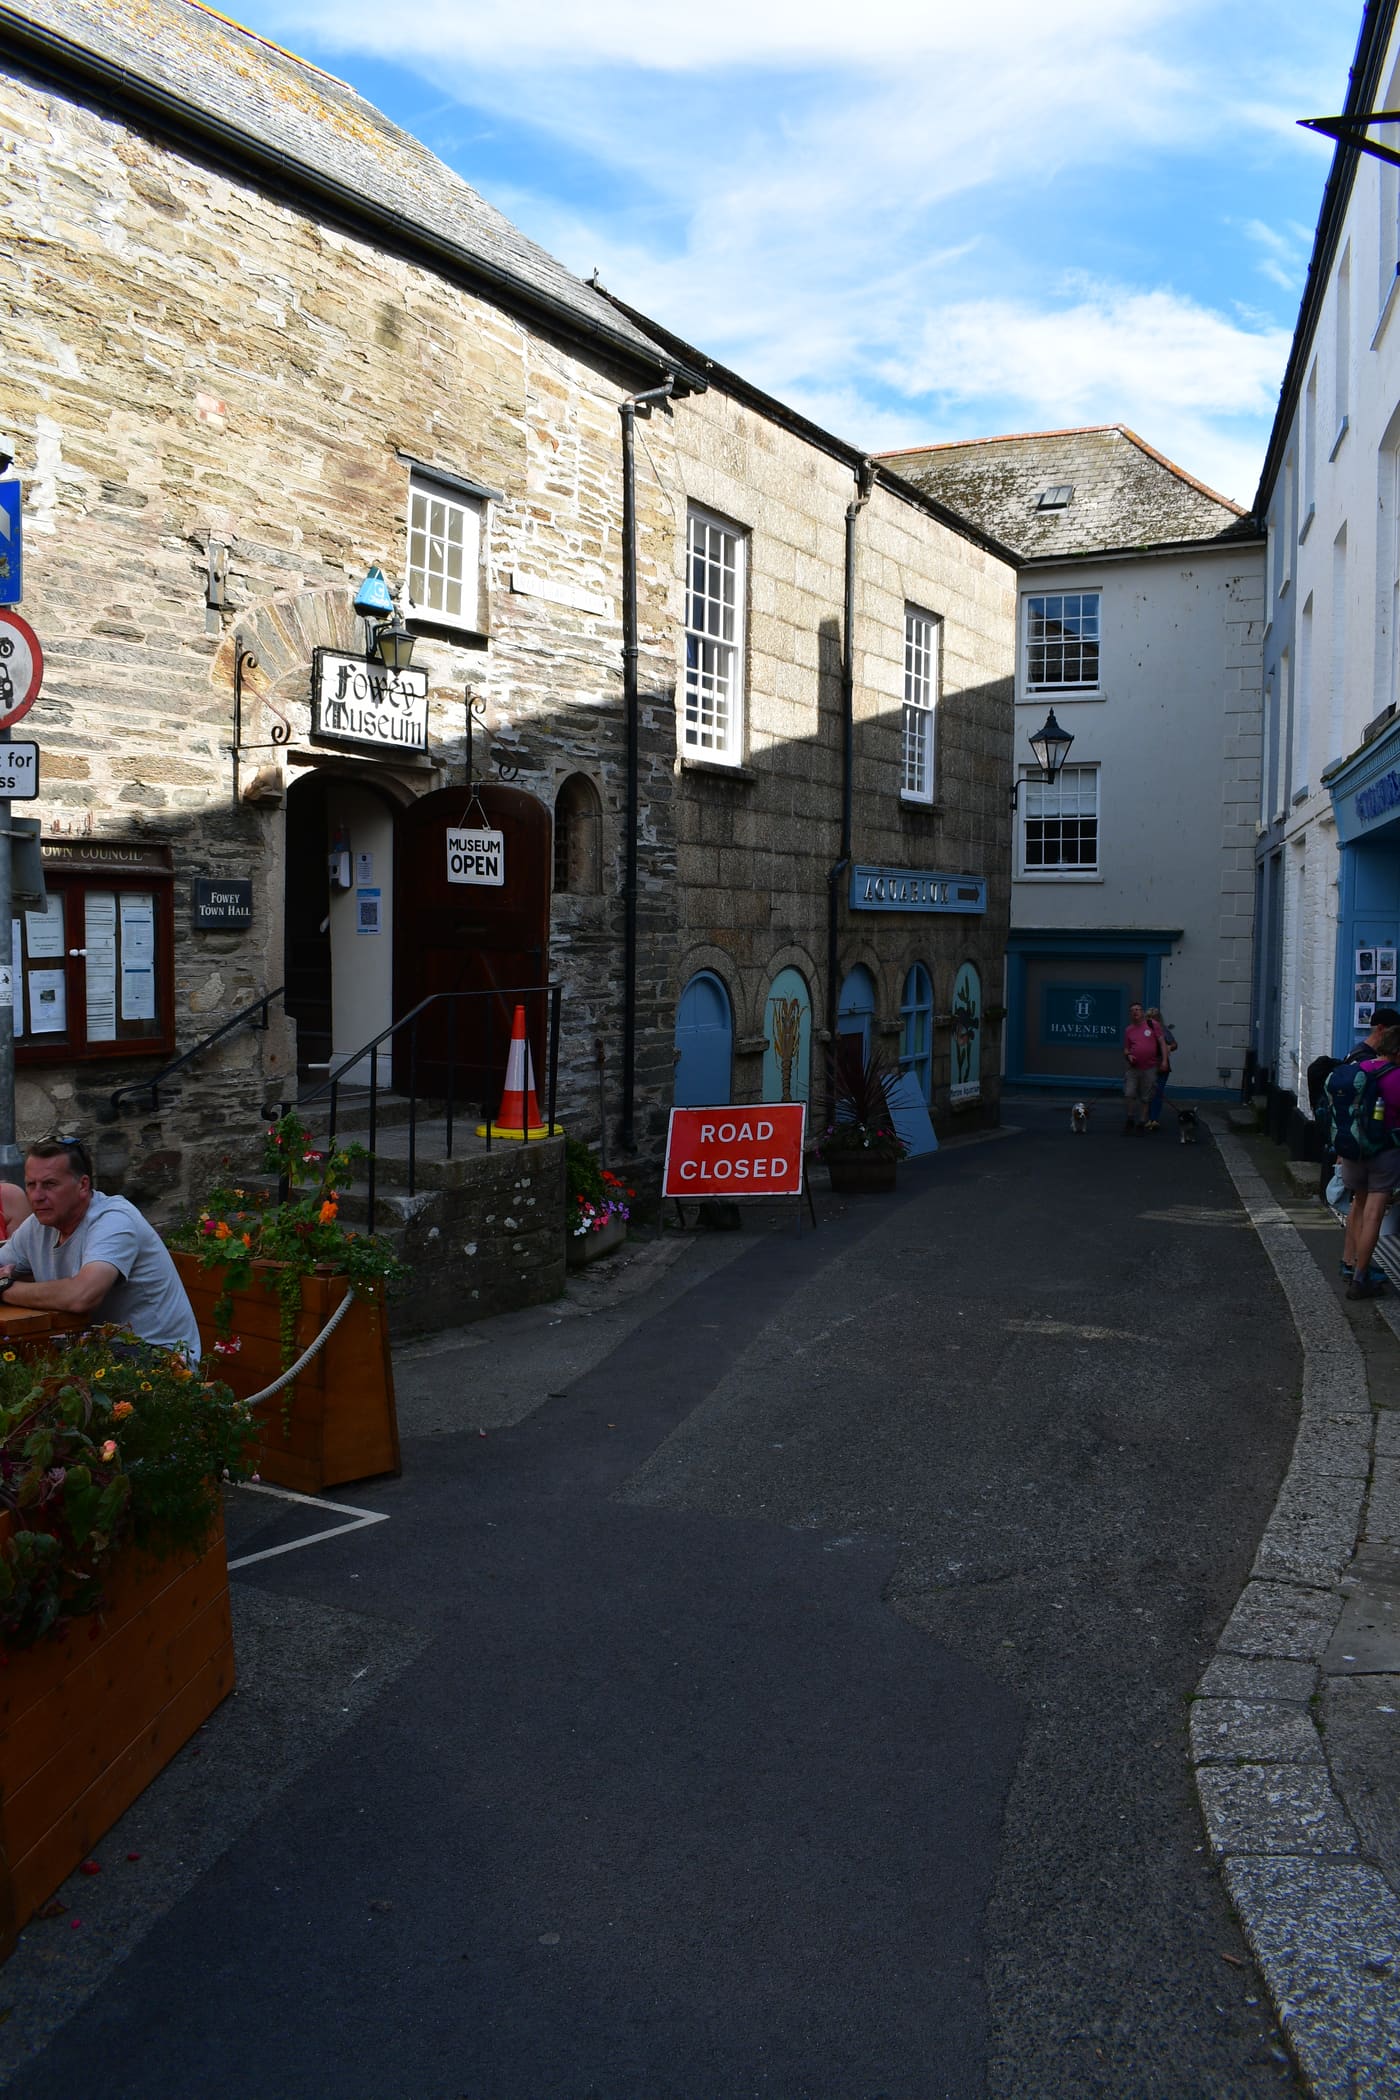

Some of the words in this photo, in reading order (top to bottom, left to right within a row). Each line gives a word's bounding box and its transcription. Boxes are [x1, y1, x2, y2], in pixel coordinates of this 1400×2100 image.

[335, 663, 415, 717] Fowey
[325, 697, 422, 745] Museum
[8, 751, 33, 768] for
[40, 845, 73, 858] OWN
[80, 846, 143, 861] COUNCIL
[449, 838, 501, 854] MUSEUM
[451, 854, 498, 877] OPEN
[211, 891, 241, 904] FOWEY
[863, 877, 949, 905] AQUARIUM
[199, 904, 225, 916] TOWN
[228, 904, 252, 916] HALL
[1051, 1023, 1117, 1035] HAVENER'S
[700, 1121, 774, 1143] ROAD
[680, 1157, 788, 1180] CLOSED
